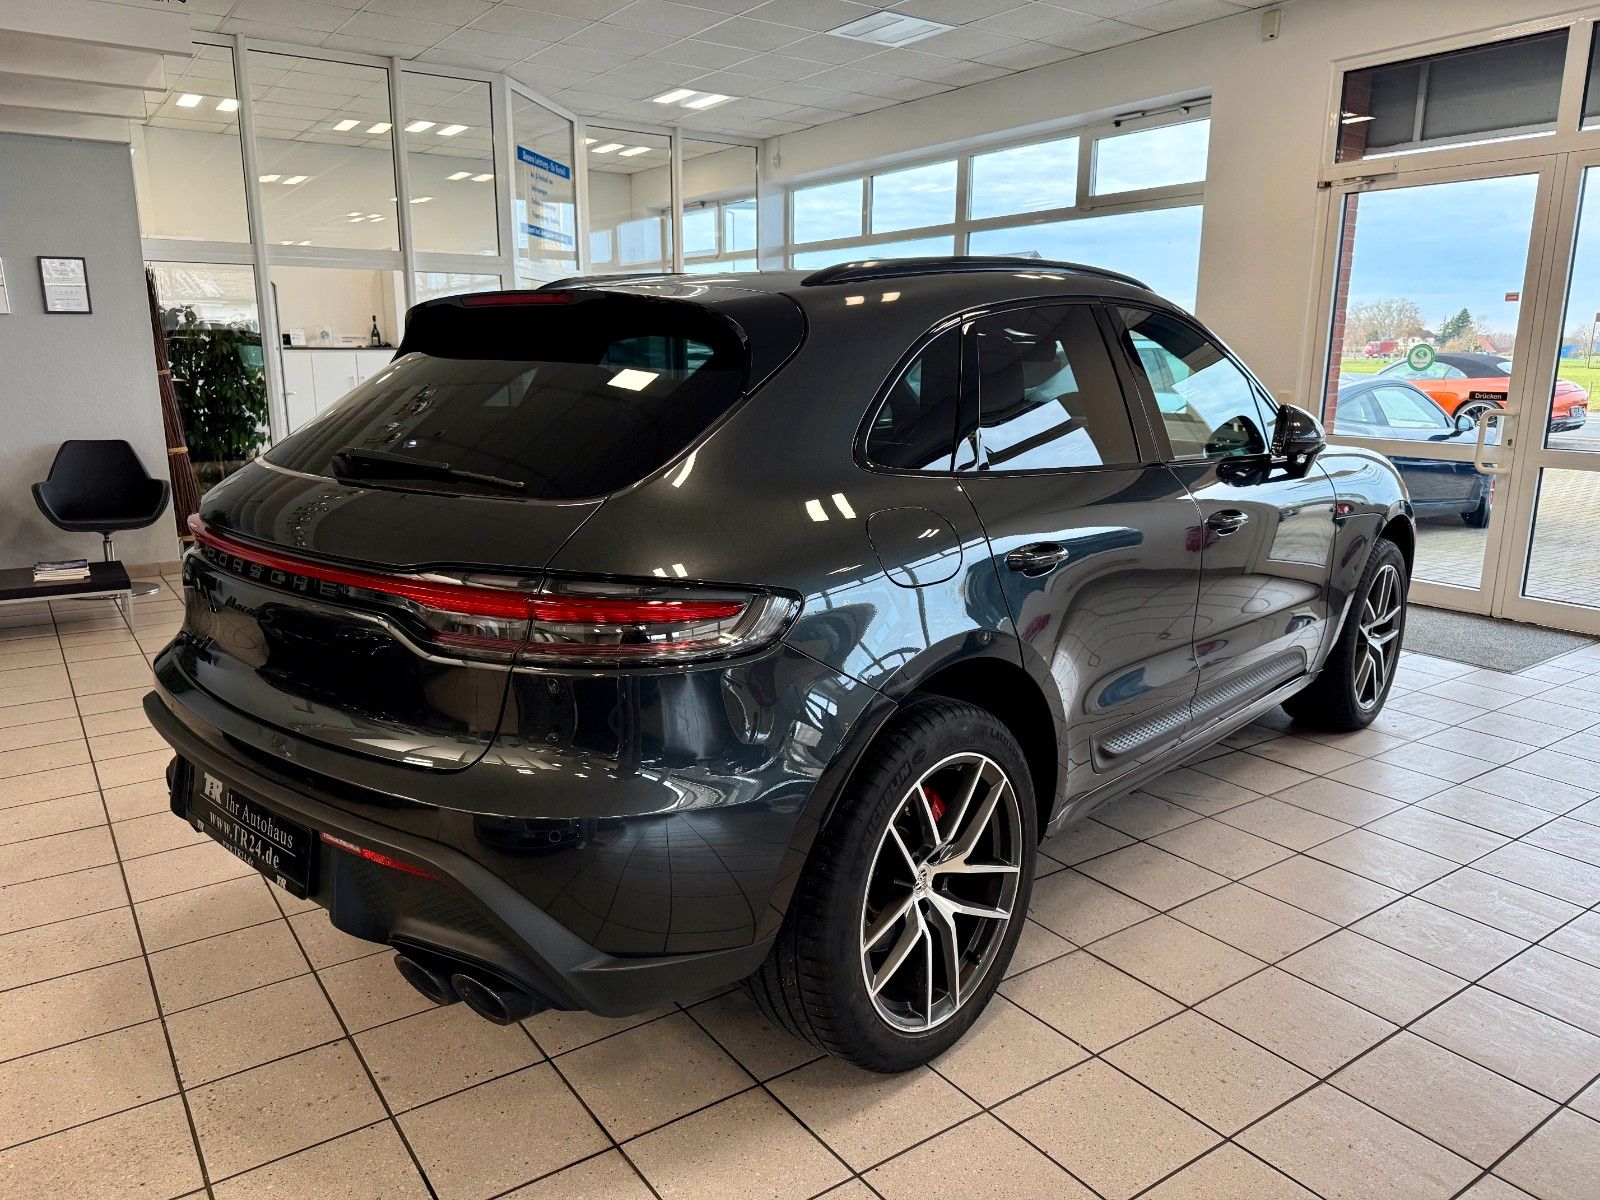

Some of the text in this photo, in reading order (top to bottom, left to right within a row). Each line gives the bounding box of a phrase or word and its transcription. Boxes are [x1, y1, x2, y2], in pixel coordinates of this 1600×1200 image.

[1475, 392, 1502, 400] Drücken
[210, 811, 280, 869] www.TR24.de
[226, 792, 293, 849] Ihr Autohaus
